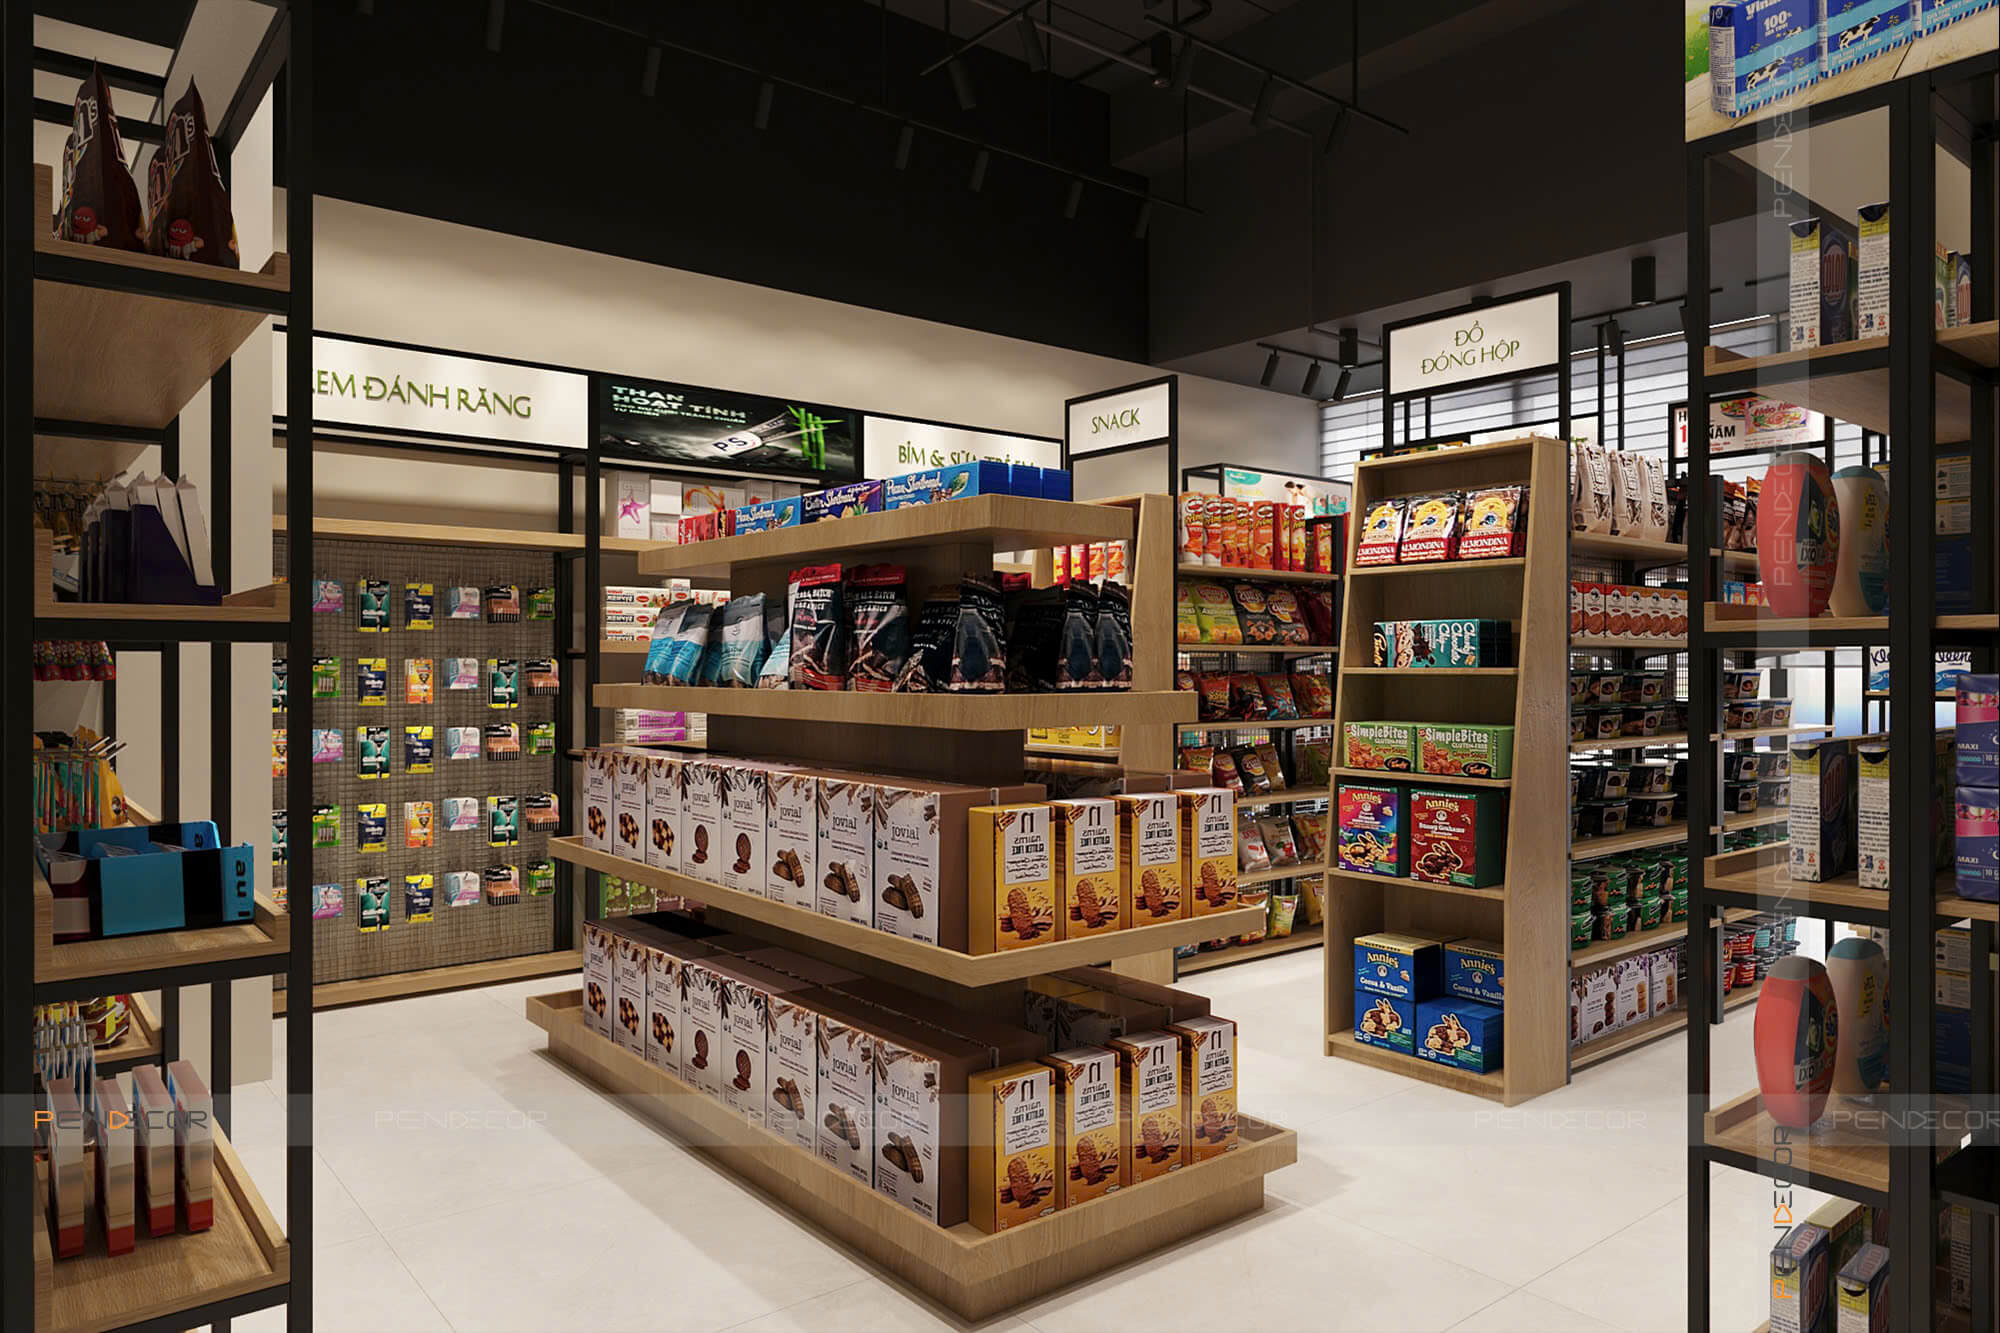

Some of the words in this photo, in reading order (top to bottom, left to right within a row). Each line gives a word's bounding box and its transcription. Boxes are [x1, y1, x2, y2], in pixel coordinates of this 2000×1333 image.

[1420, 350, 1476, 375] ĐÓNG
[1481, 339, 1520, 363] HỘP
[312, 369, 357, 398] EM
[362, 374, 450, 410] ĐÁNH
[456, 386, 532, 419] RĂNG
[611, 385, 684, 402] THAN
[1091, 406, 1141, 434] SNACK
[929, 452, 945, 468] &
[1350, 725, 1408, 740] SimpleBites
[1425, 728, 1489, 743] SimpleBites
[1957, 742, 1979, 751] MAXI
[1351, 791, 1382, 805] Annie's
[1425, 798, 1459, 812] Annie's
[779, 803, 802, 821] jovial
[832, 812, 857, 832] jovial
[891, 821, 920, 842] jovial
[1957, 855, 1979, 864] MAXI
[1367, 951, 1399, 969] Annie's
[1460, 958, 1496, 975] Annie's
[779, 1029, 802, 1052] jovial
[832, 1053, 857, 1079] jovial
[891, 1079, 921, 1106] jovial
